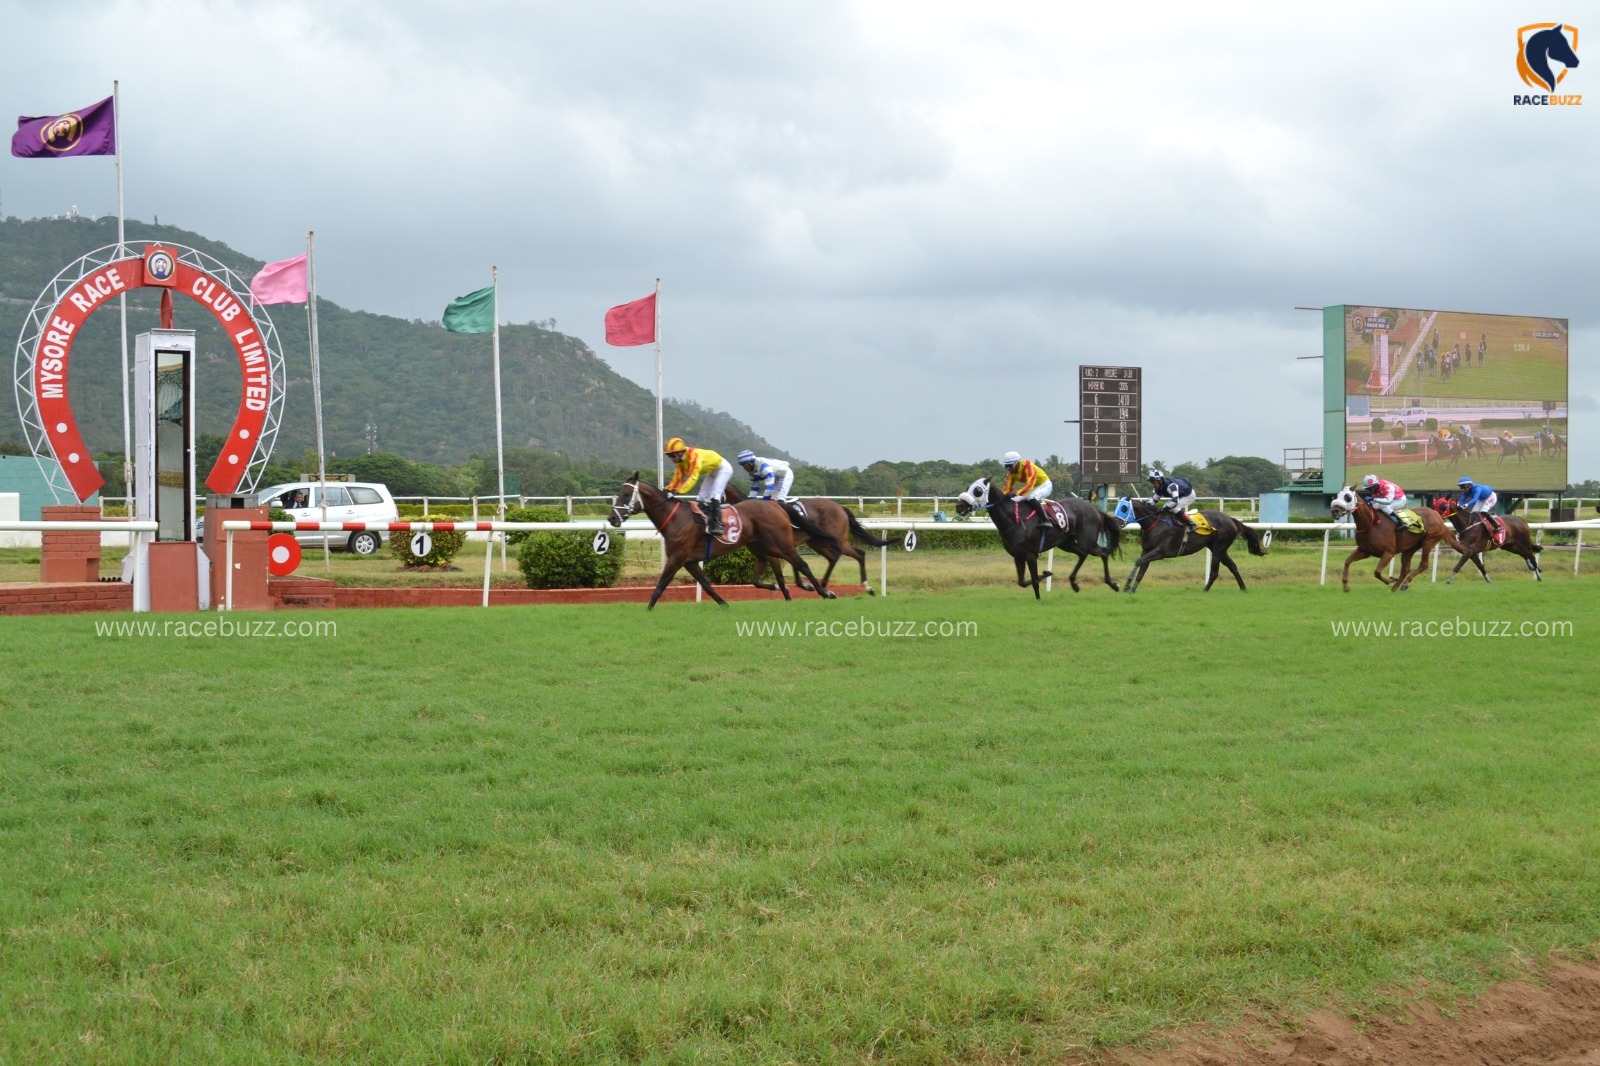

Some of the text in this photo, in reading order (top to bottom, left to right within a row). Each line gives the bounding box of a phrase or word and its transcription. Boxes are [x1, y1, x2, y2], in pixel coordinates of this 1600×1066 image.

[40, 268, 267, 411] MYSORE RACE CLUB LIMITED
[1056, 512, 1066, 529] 8
[596, 533, 607, 552] 2
[727, 526, 740, 543] 6
[906, 533, 913, 550] 4
[1265, 532, 1271, 547] 7
[415, 535, 424, 555] 1
